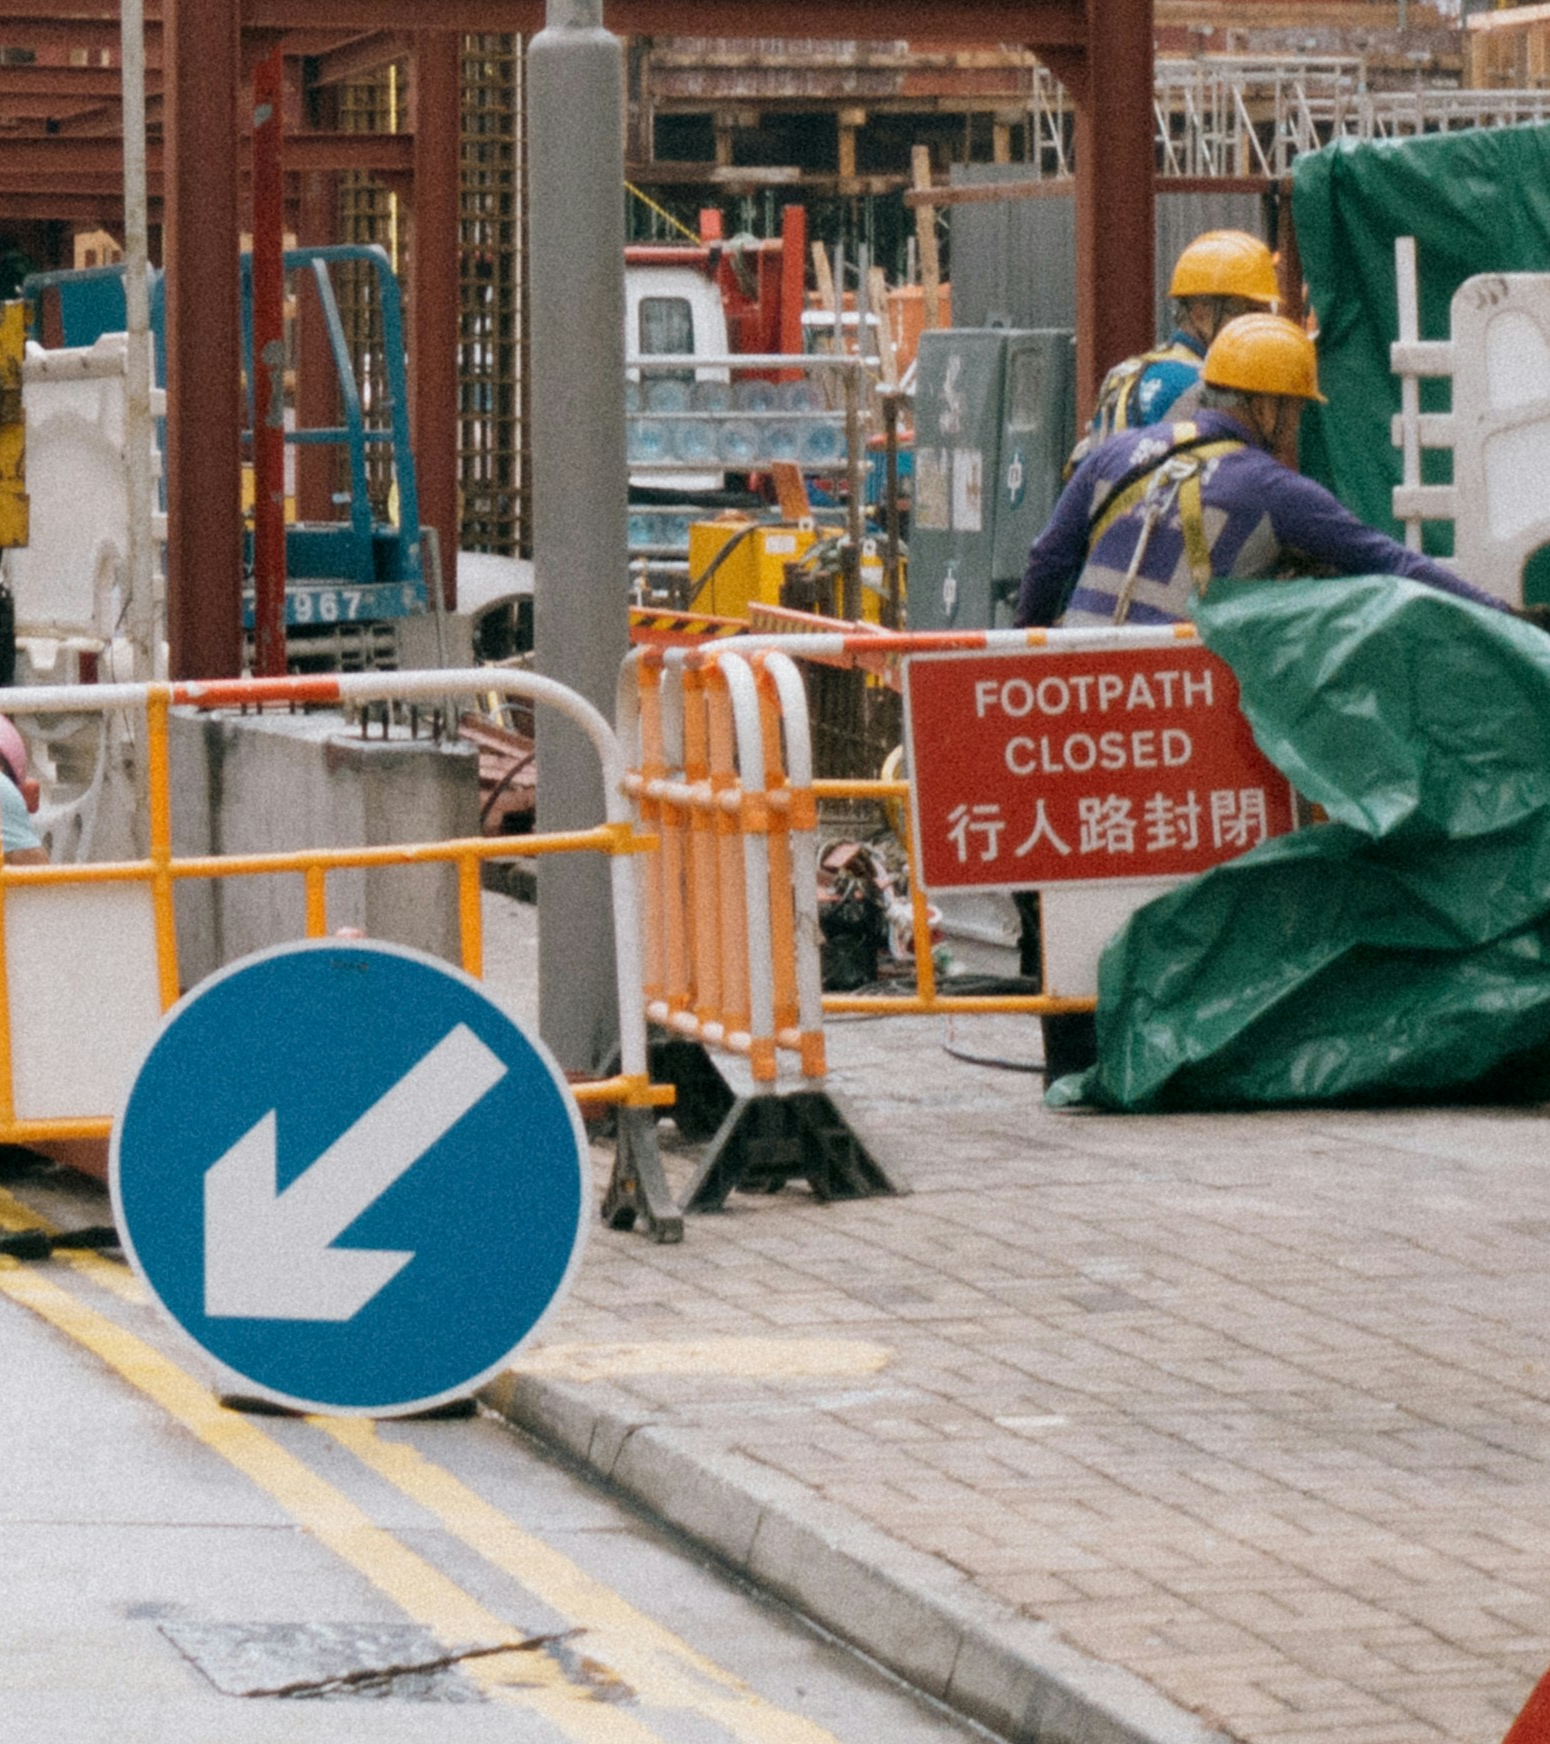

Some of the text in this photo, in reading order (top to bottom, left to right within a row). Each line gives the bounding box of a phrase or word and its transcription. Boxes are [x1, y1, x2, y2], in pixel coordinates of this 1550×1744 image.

[974, 668, 1215, 718] FOOTPATH
[1004, 729, 1193, 776] CLOSED
[946, 787, 1269, 864] 行人路封閉
